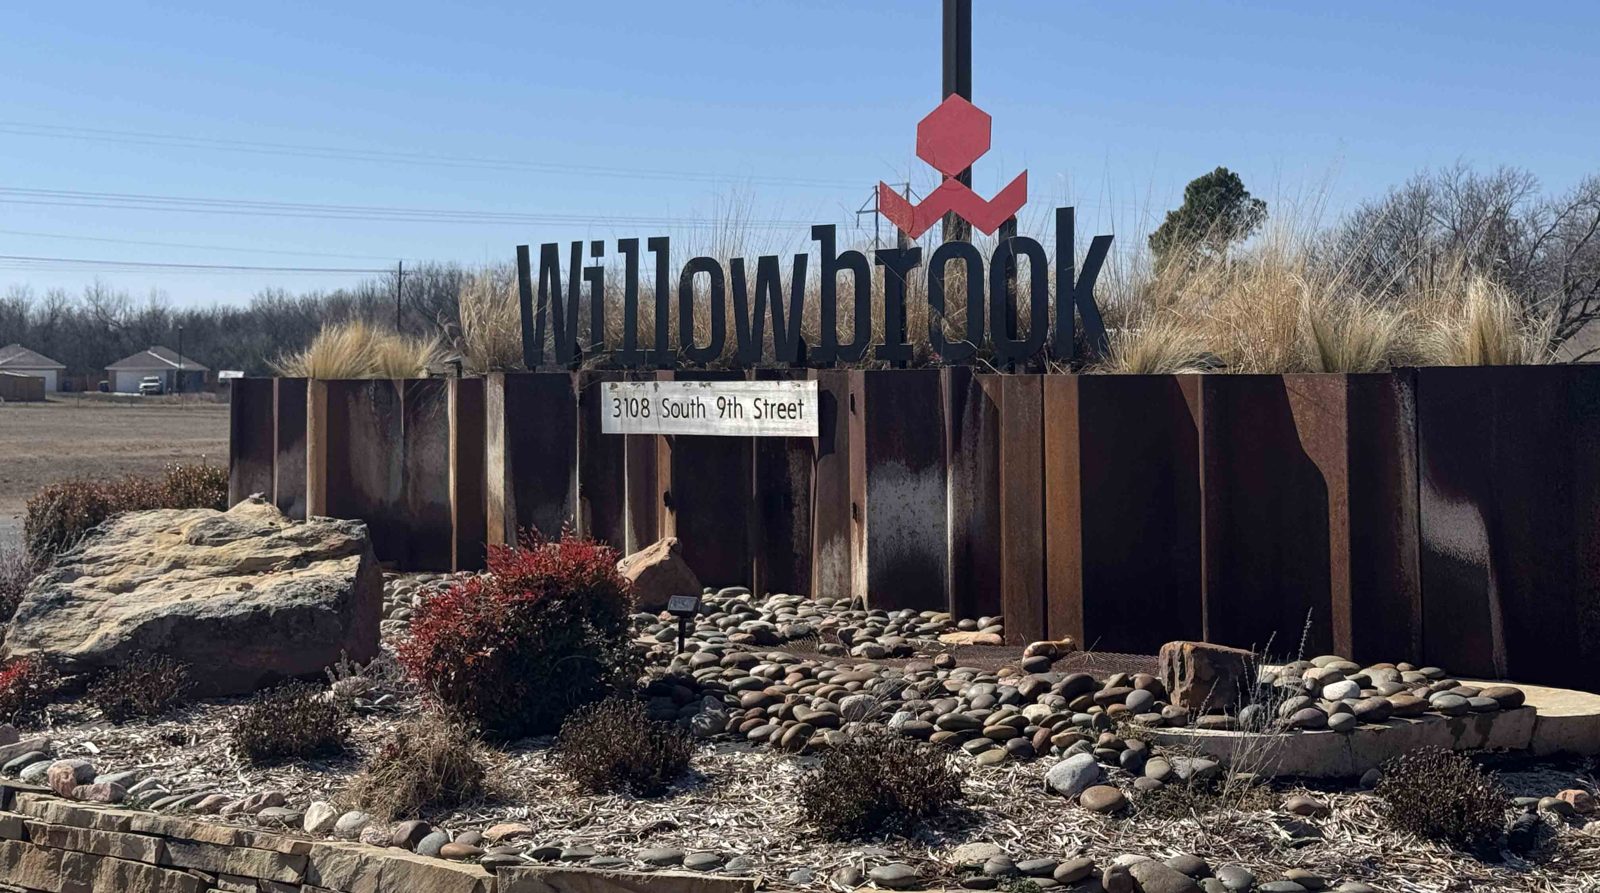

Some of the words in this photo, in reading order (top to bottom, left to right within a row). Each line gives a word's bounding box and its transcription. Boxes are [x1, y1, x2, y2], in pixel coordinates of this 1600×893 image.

[516, 207, 1114, 368] Willowbrook
[612, 397, 651, 418] 3108
[661, 396, 706, 419] South
[716, 396, 743, 419] 9th
[753, 397, 804, 420] Street
